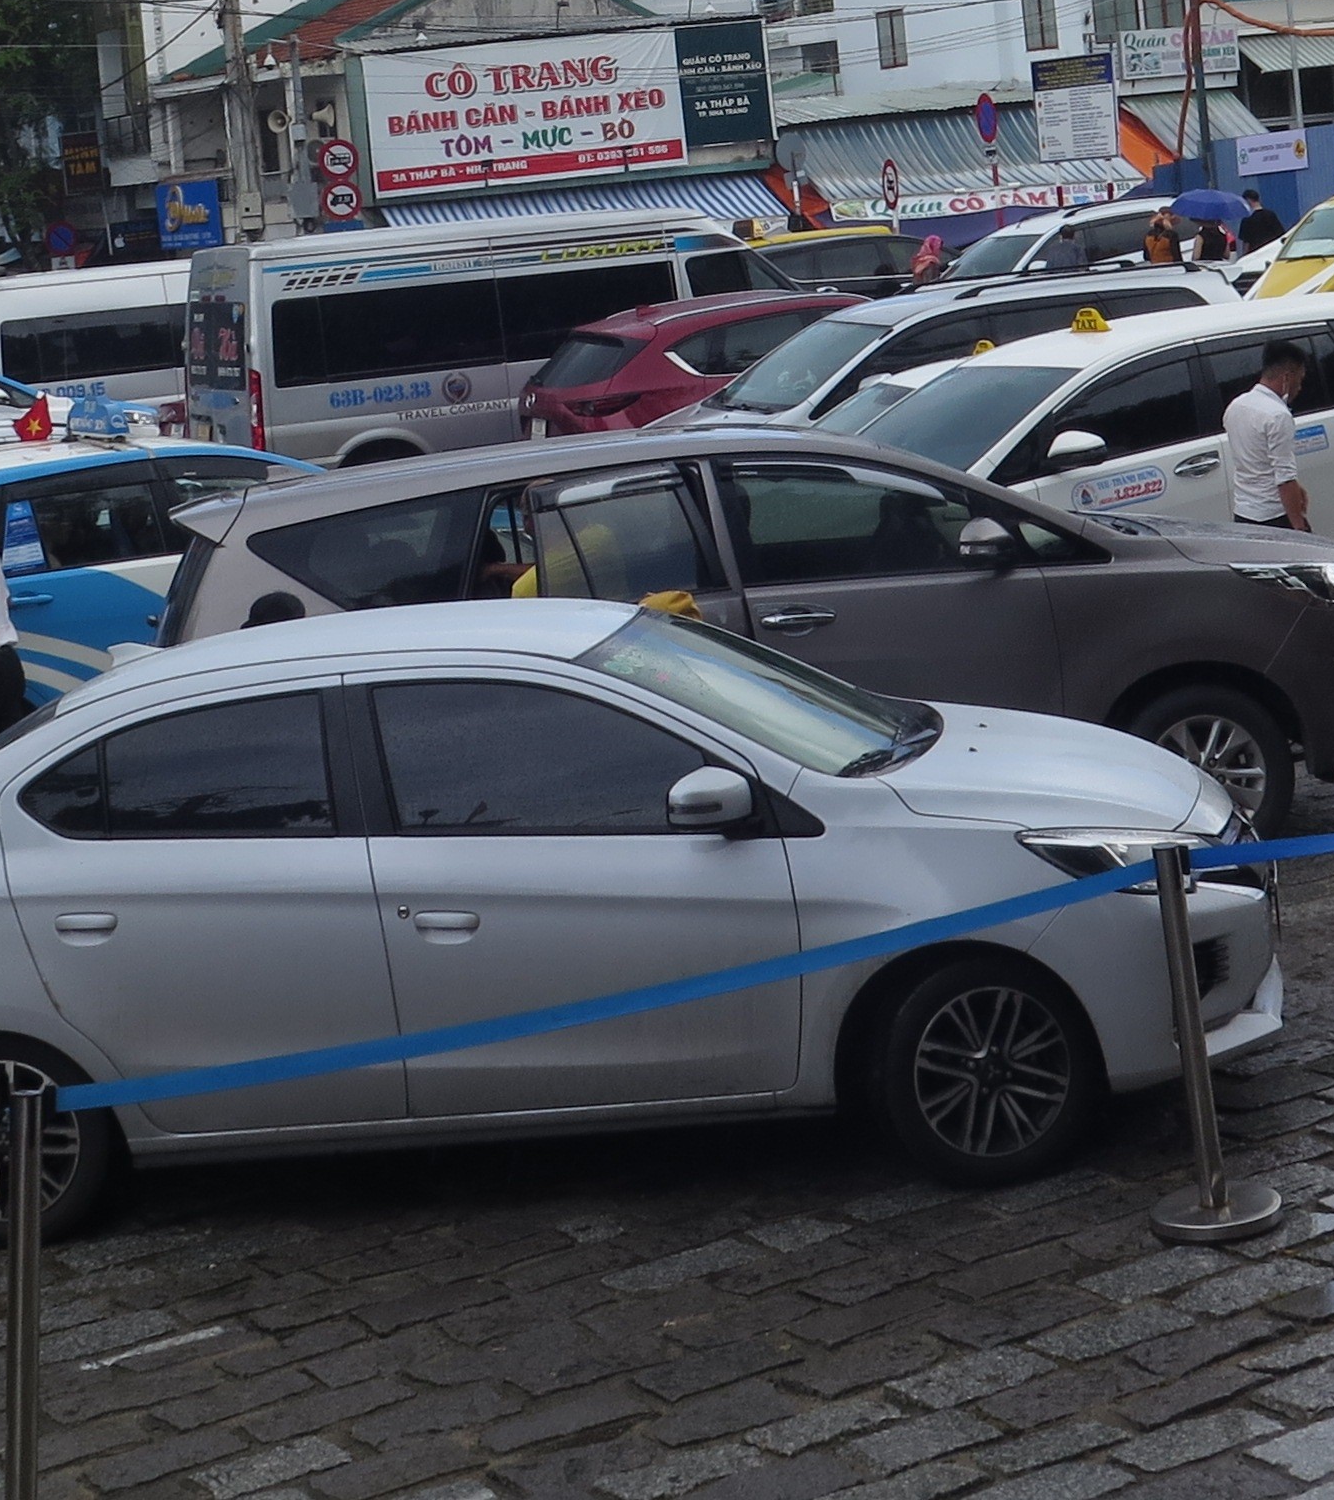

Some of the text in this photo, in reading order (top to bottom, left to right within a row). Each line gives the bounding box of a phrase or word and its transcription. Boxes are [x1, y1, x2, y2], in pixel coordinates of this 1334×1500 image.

[1123, 32, 1168, 52] Quán
[708, 53, 722, 64] CÔ
[723, 52, 751, 63] TRANG
[424, 55, 619, 101] CÔ TRANG
[388, 110, 460, 137] BÁNH
[541, 95, 612, 122] BÁNH
[617, 86, 667, 112] XÈO
[710, 96, 736, 109] THÁP
[737, 95, 750, 107] BÀ
[441, 132, 494, 158] TÔM
[522, 126, 575, 152] MỰC
[601, 117, 636, 142] BÒ
[392, 173, 407, 183] 3A
[410, 168, 438, 181] THÁP
[441, 166, 456, 178] BÀ
[492, 160, 528, 173] TRANG
[949, 192, 985, 215] CÔ
[539, 239, 664, 264] LUXURY
[1075, 319, 1098, 331] TAXI
[329, 379, 432, 410] 63B-023.33
[396, 398, 511, 421] TRAVEL COMPANY
